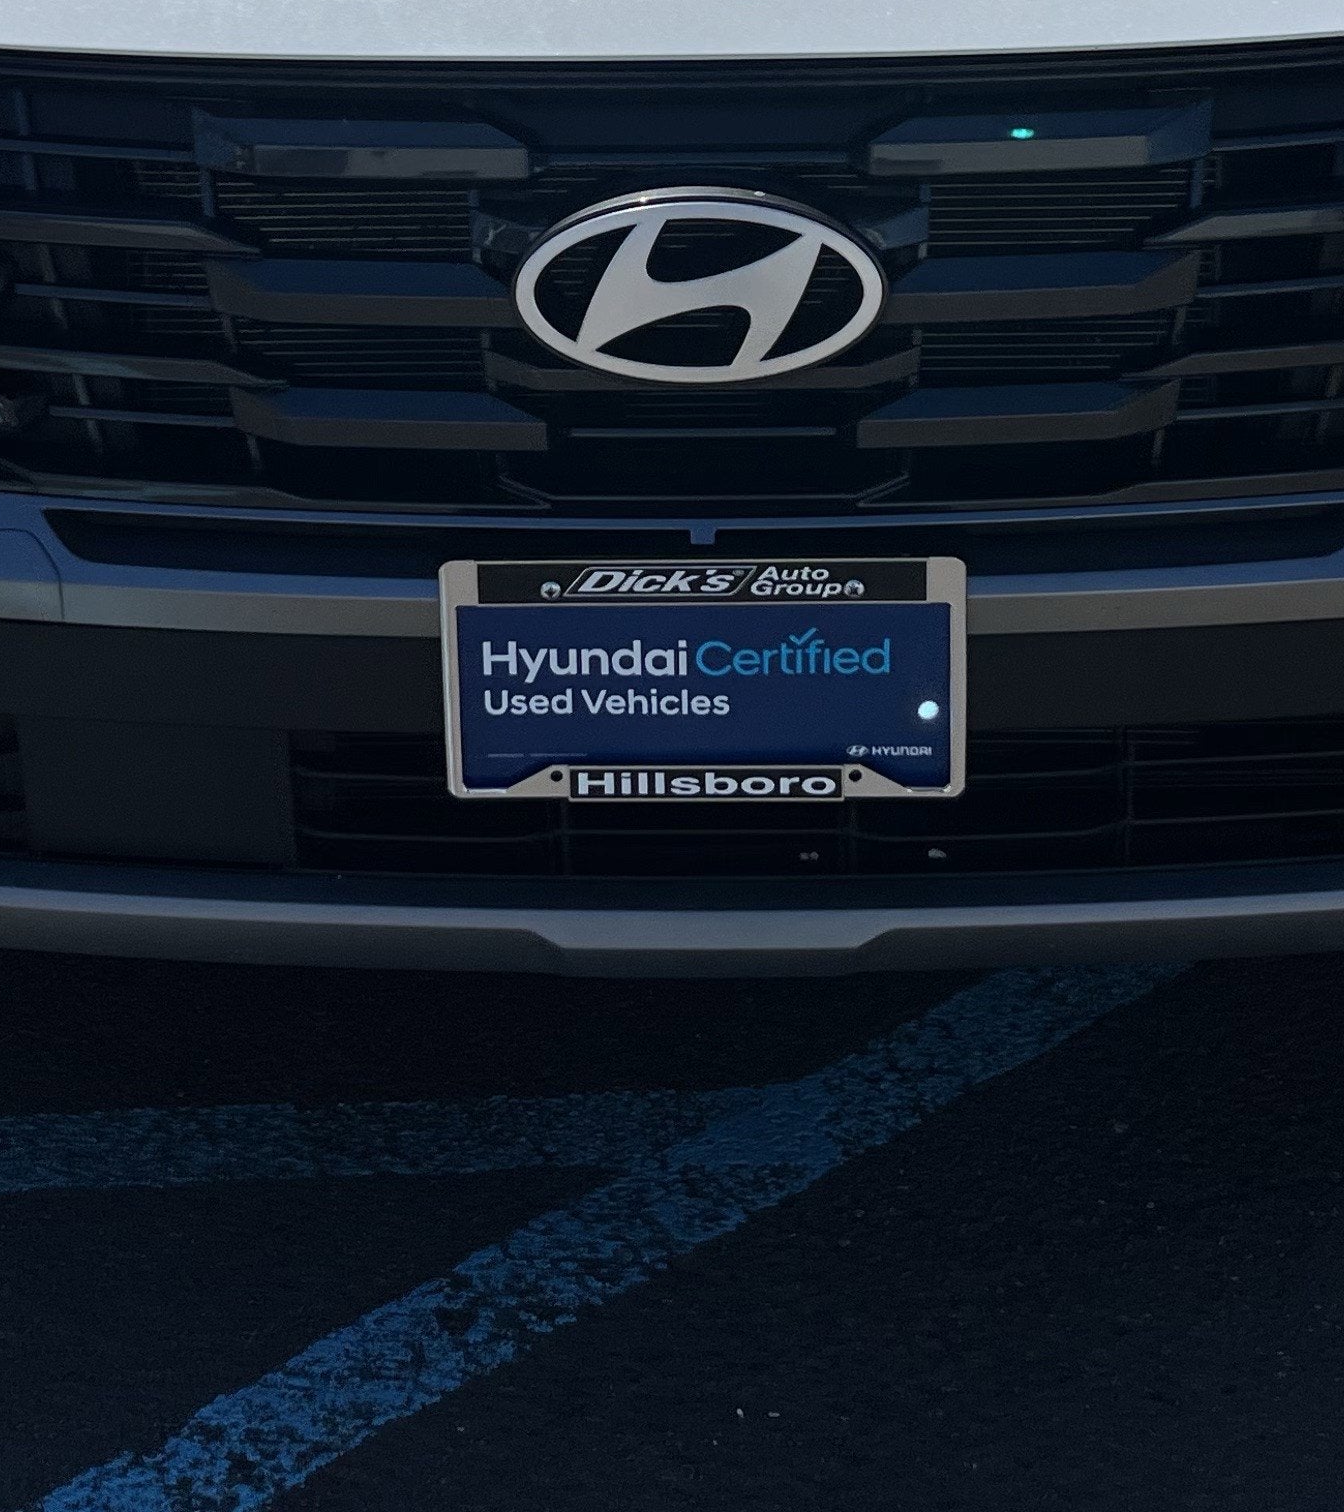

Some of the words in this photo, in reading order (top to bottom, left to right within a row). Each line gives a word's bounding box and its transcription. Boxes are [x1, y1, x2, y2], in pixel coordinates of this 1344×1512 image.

[577, 569, 735, 593] Dick's
[757, 566, 829, 581] Auto
[750, 580, 843, 598] Group
[482, 639, 688, 684] Hyundai
[696, 628, 892, 677] Certified
[484, 688, 574, 716] Used
[580, 688, 731, 716] Vehicles
[871, 745, 933, 757] HYUNDAI
[577, 771, 837, 796] Hillsboro
